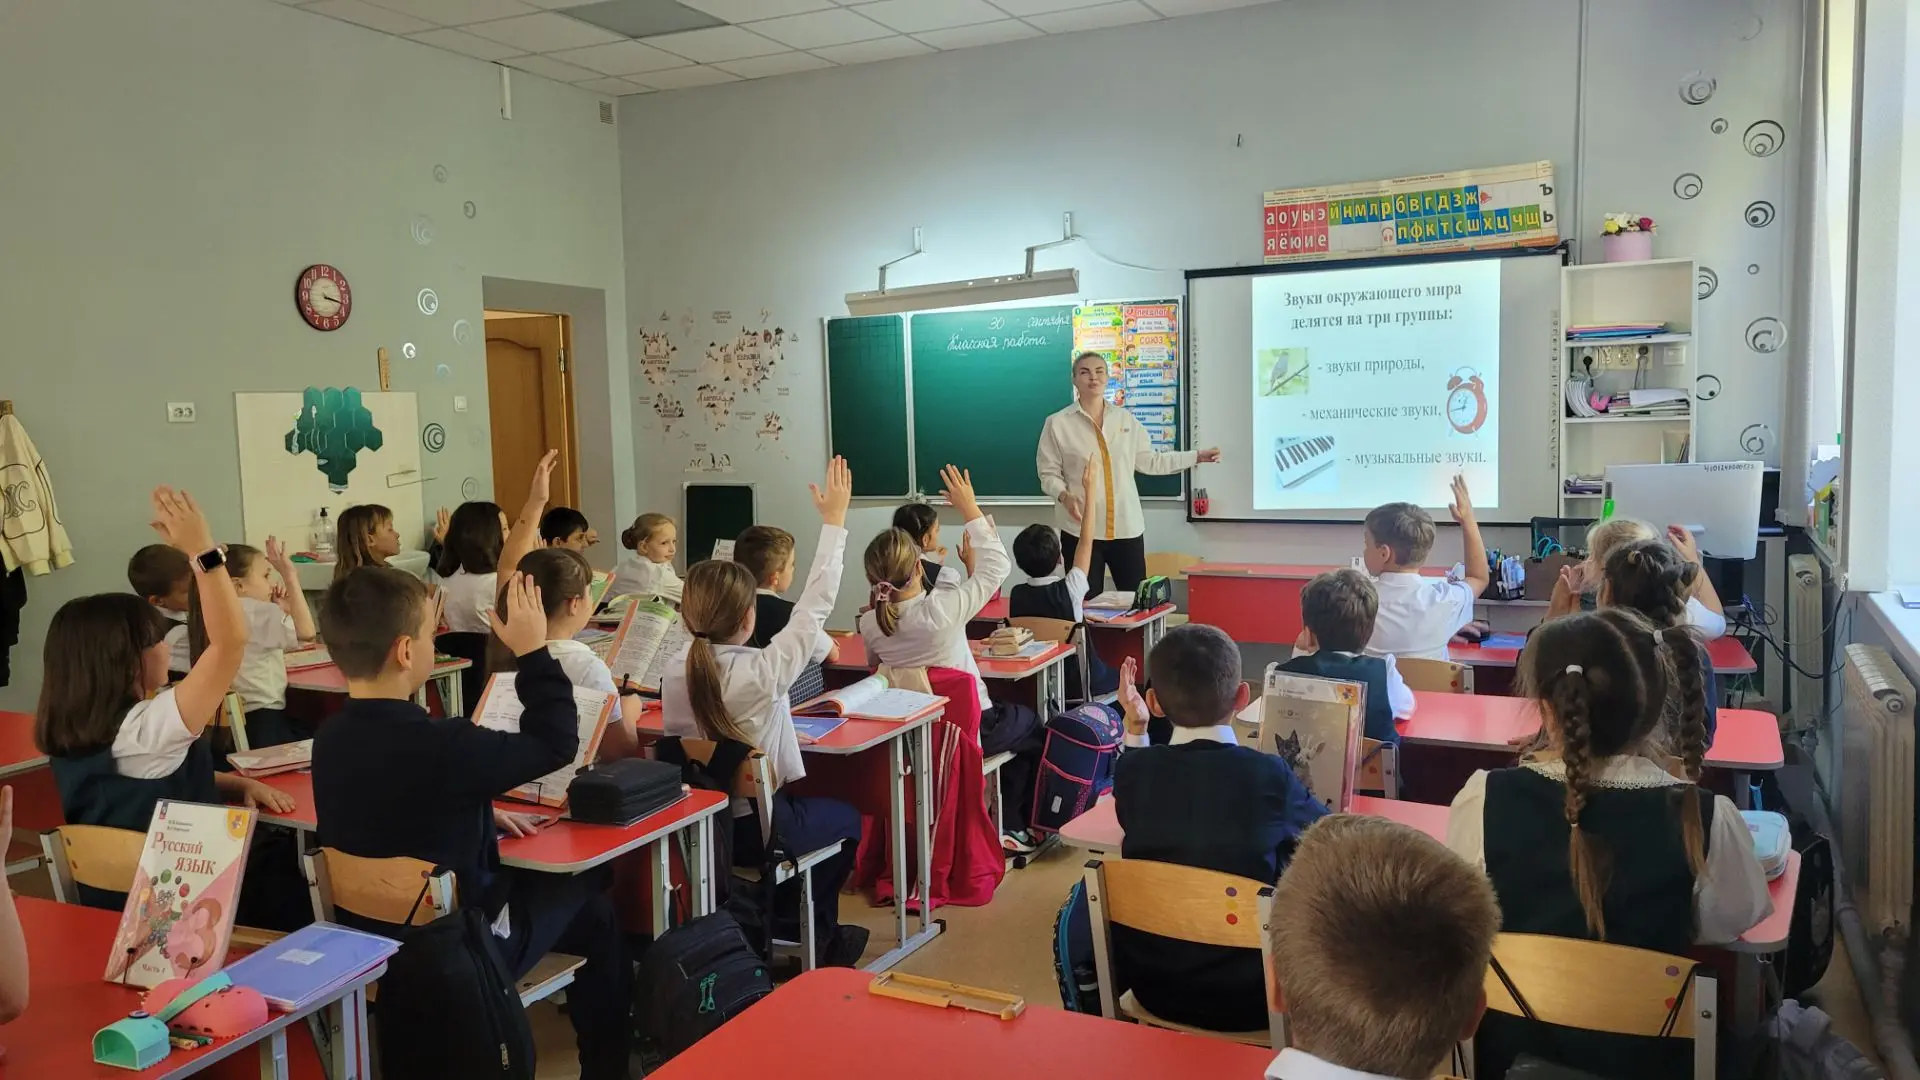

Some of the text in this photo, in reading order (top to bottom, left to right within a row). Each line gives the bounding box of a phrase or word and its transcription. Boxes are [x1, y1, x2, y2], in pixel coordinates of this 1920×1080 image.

[1330, 203, 1339, 219] й
[1343, 204, 1351, 217] н
[1355, 204, 1366, 217] м
[1381, 200, 1391, 218] р
[1396, 193, 1405, 213] б
[1410, 200, 1419, 211] в
[1425, 197, 1432, 209] г
[1437, 195, 1449, 210] д
[1453, 194, 1461, 207] з
[1267, 208, 1325, 226] а о у ы э
[1398, 227, 1407, 238] п
[1411, 222, 1422, 242] ф
[1426, 224, 1435, 236] к
[1440, 222, 1449, 234] т
[1456, 221, 1463, 233] с
[1467, 220, 1480, 232] ш
[1484, 218, 1493, 230] х
[1497, 216, 1509, 231] ц
[1512, 215, 1523, 226] ч
[1526, 212, 1539, 227] щ
[1267, 233, 1326, 251] я ё ю и е
[312, 269, 317, 280] 11
[321, 266, 329, 277] 12
[333, 270, 336, 281] 1
[304, 278, 311, 288] 10
[340, 280, 345, 290] 2
[302, 291, 308, 300] 9
[343, 294, 348, 304] 3
[1284, 284, 1462, 309] Звуки окружающего мира
[306, 304, 311, 314] 8
[340, 307, 345, 316] 4
[314, 315, 319, 324] 7
[324, 319, 329, 328] 6
[333, 316, 339, 326] 5
[1291, 308, 1453, 330] делятся на три группы:
[1002, 330, 1047, 350] работа
[1326, 360, 1360, 376] звуки
[1364, 357, 1425, 376] природы,
[1310, 406, 1398, 420] механические
[1355, 453, 1441, 468] музыкальные
[151, 831, 203, 854] Русский
